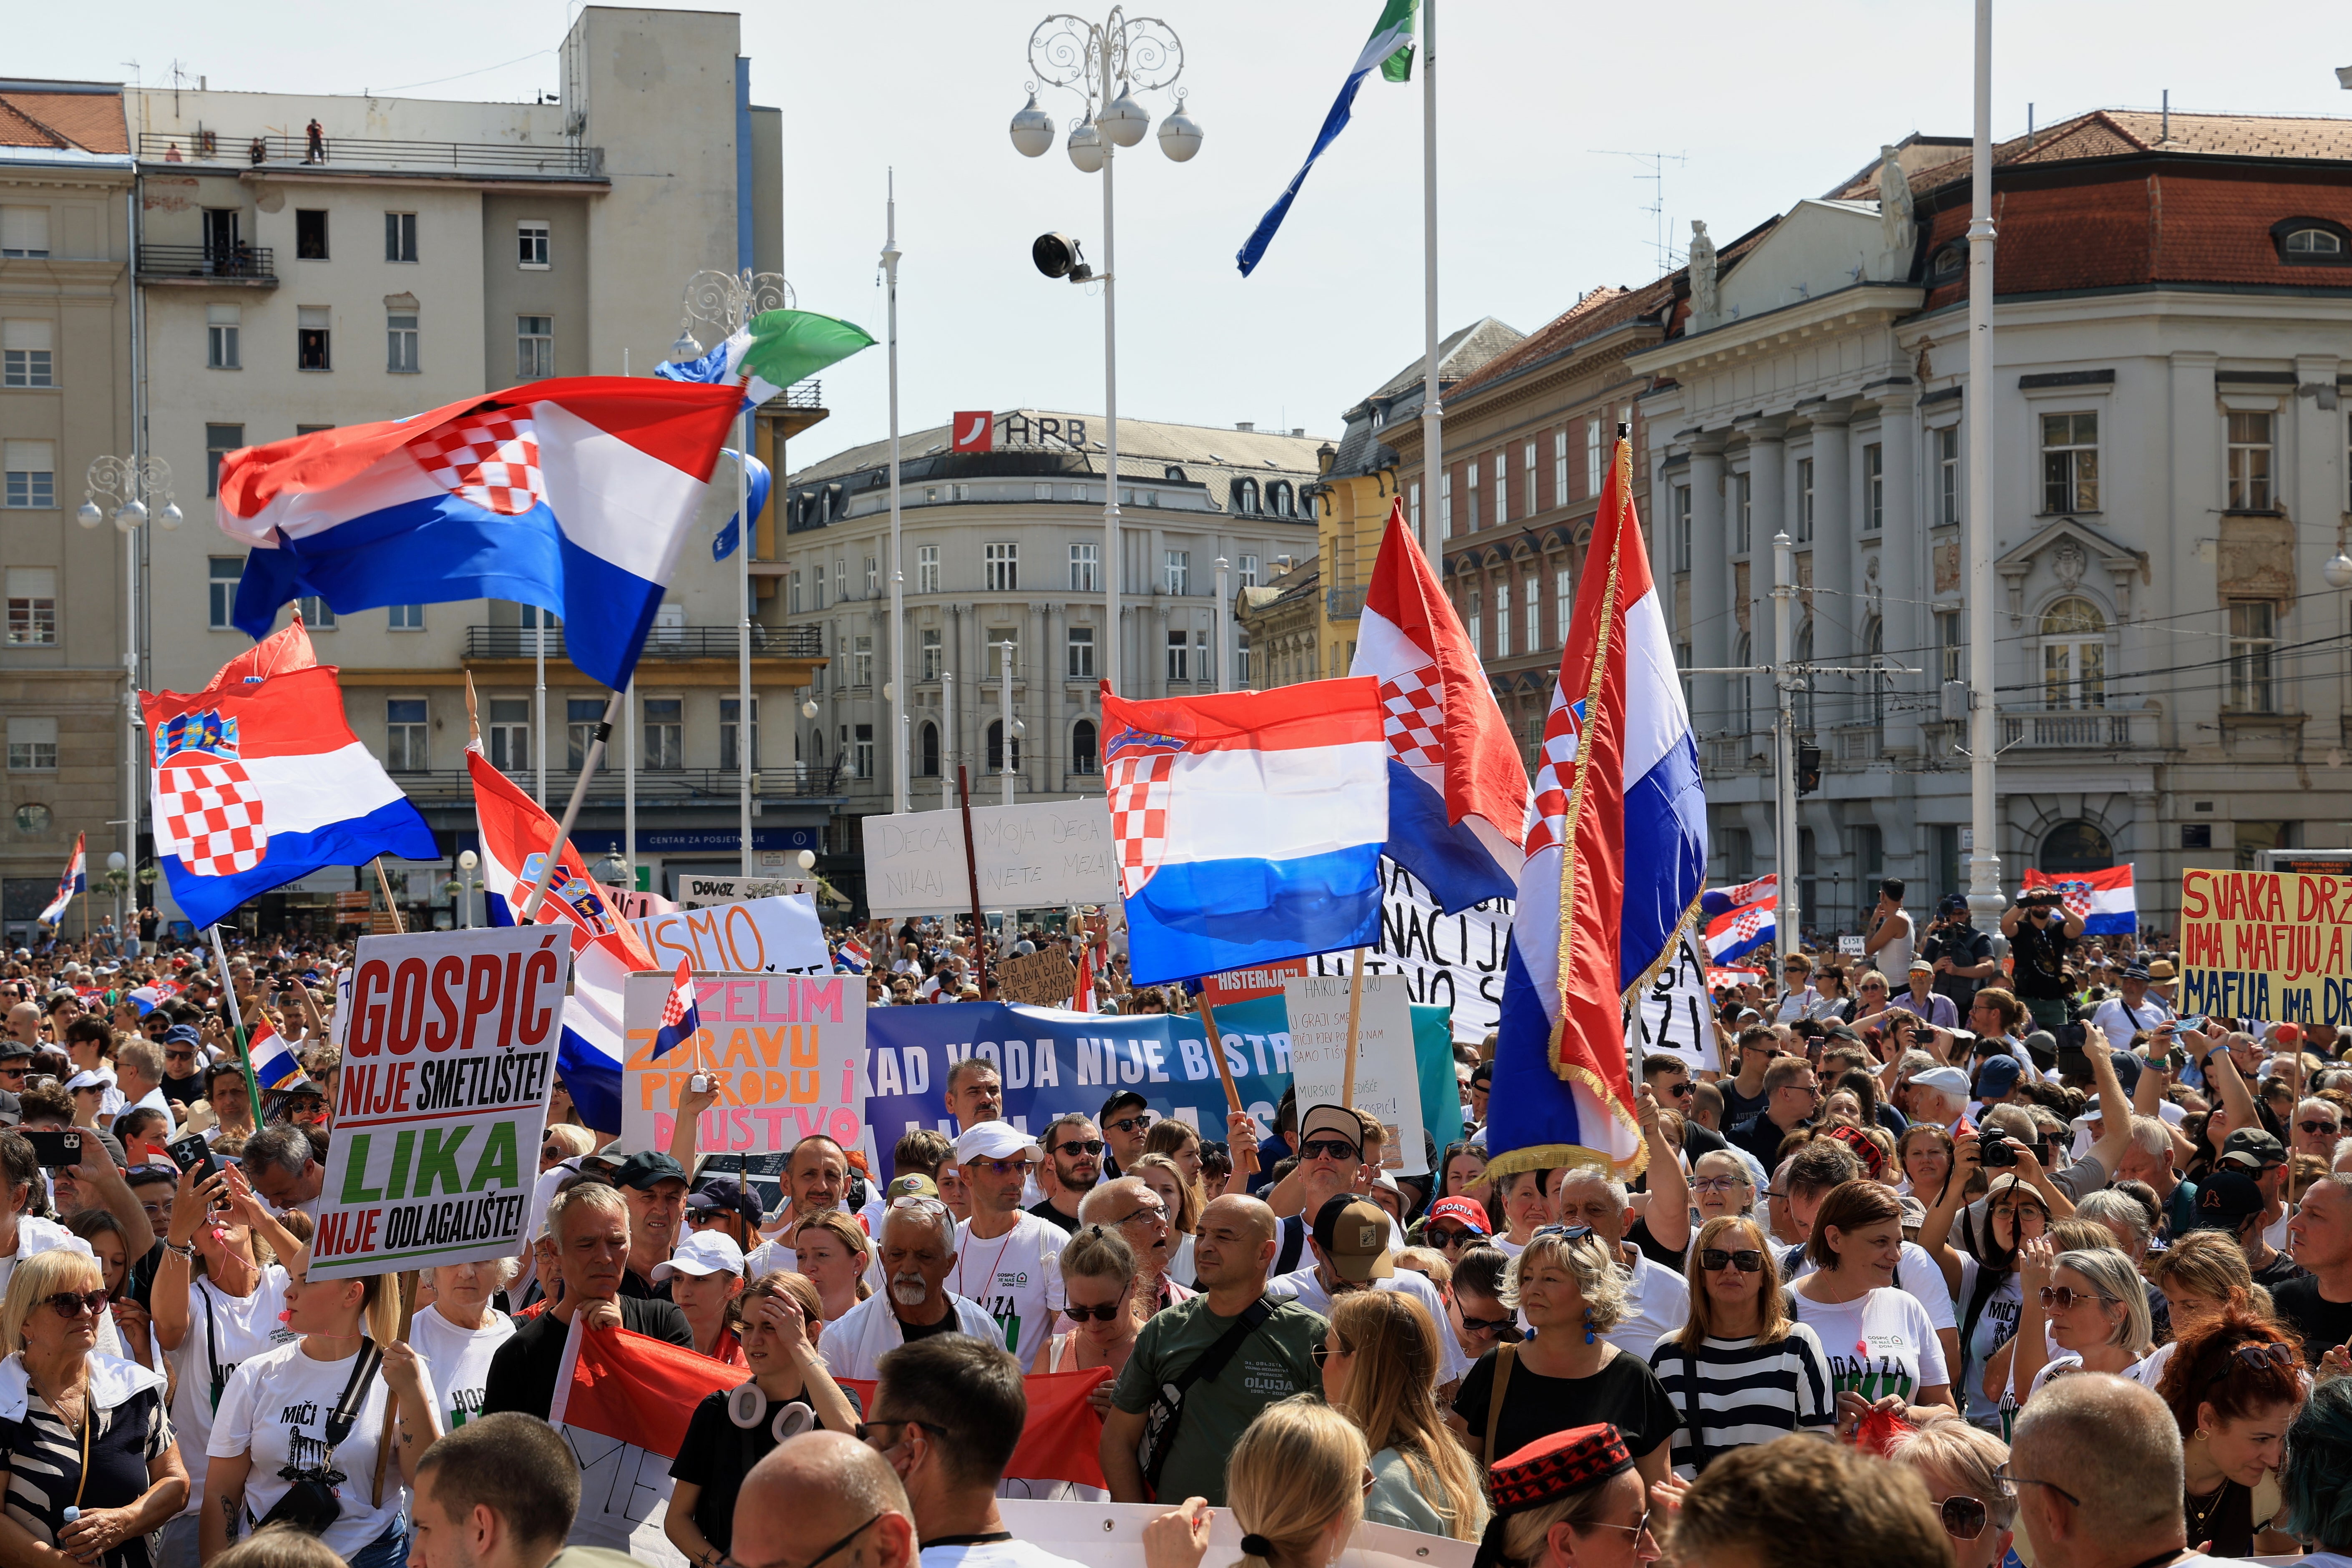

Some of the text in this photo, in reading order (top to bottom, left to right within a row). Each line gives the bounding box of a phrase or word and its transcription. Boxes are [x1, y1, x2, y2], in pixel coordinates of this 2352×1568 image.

[1006, 417, 1085, 446] HRB
[984, 818, 1036, 854] MOJA
[1049, 814, 1099, 843] DECA
[691, 880, 736, 897] DOVOZ
[885, 869, 943, 898] NIKAJ
[987, 866, 1042, 890] NETE
[2182, 870, 2286, 922] SVAKA
[2186, 922, 2226, 968] IMA
[348, 934, 557, 1058] GOSPIĆ
[1305, 979, 1336, 998] HAIKU
[2183, 969, 2271, 1021] MAFIJA
[2282, 988, 2314, 1024] IMA
[1290, 1014, 1298, 1029] U
[1302, 1013, 1329, 1028] GRAJI
[626, 1025, 819, 1070] ZDRAVU
[1316, 1032, 1333, 1044] PJEV
[1366, 1029, 1384, 1040] NAM
[1077, 1038, 1169, 1085] NIJE
[1294, 1050, 1319, 1063] SAMO
[339, 1047, 549, 1117] NIJE SMETLIŠTE!
[1298, 1084, 1335, 1100] MURSKO
[654, 1104, 860, 1152] DUŠTVO
[340, 1121, 519, 1205] LIKA
[314, 1191, 524, 1257] NIJE ODLAGALIŠTE!
[1436, 1203, 1473, 1217] CROATIA
[993, 1296, 1015, 1321] ZA
[269, 1326, 286, 1336] OSPIĆ
[1879, 1355, 1908, 1382] ZA
[1245, 1377, 1294, 1391] OLUJA
[280, 1400, 318, 1426] MIČI
